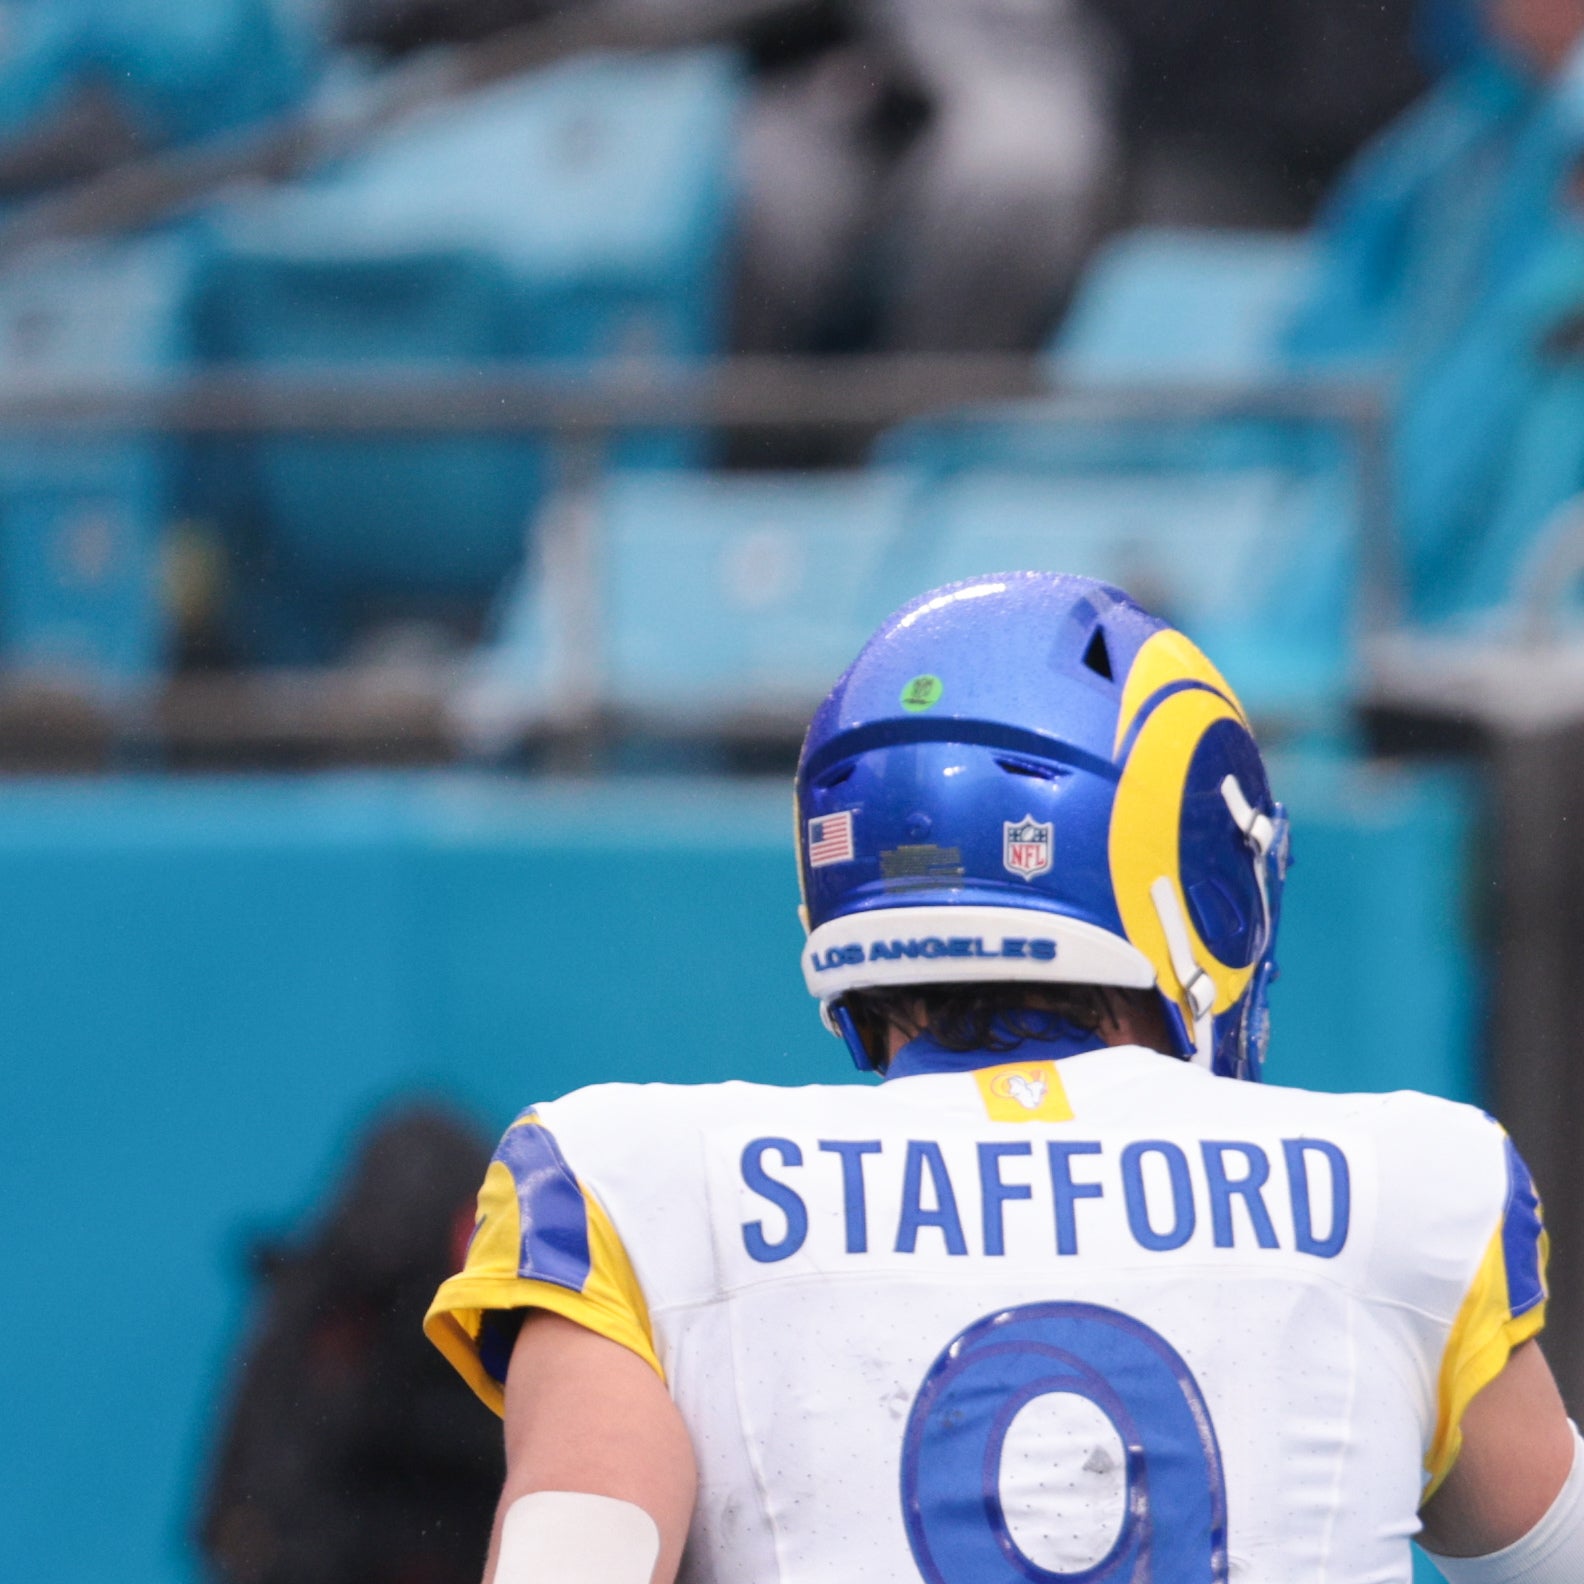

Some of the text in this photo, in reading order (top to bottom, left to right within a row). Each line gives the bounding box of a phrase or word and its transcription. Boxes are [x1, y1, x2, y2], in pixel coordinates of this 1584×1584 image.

[1010, 844, 1047, 869] NFL
[811, 937, 1057, 972] LOS ANGELES
[739, 1135, 1350, 1264] STAFFORD
